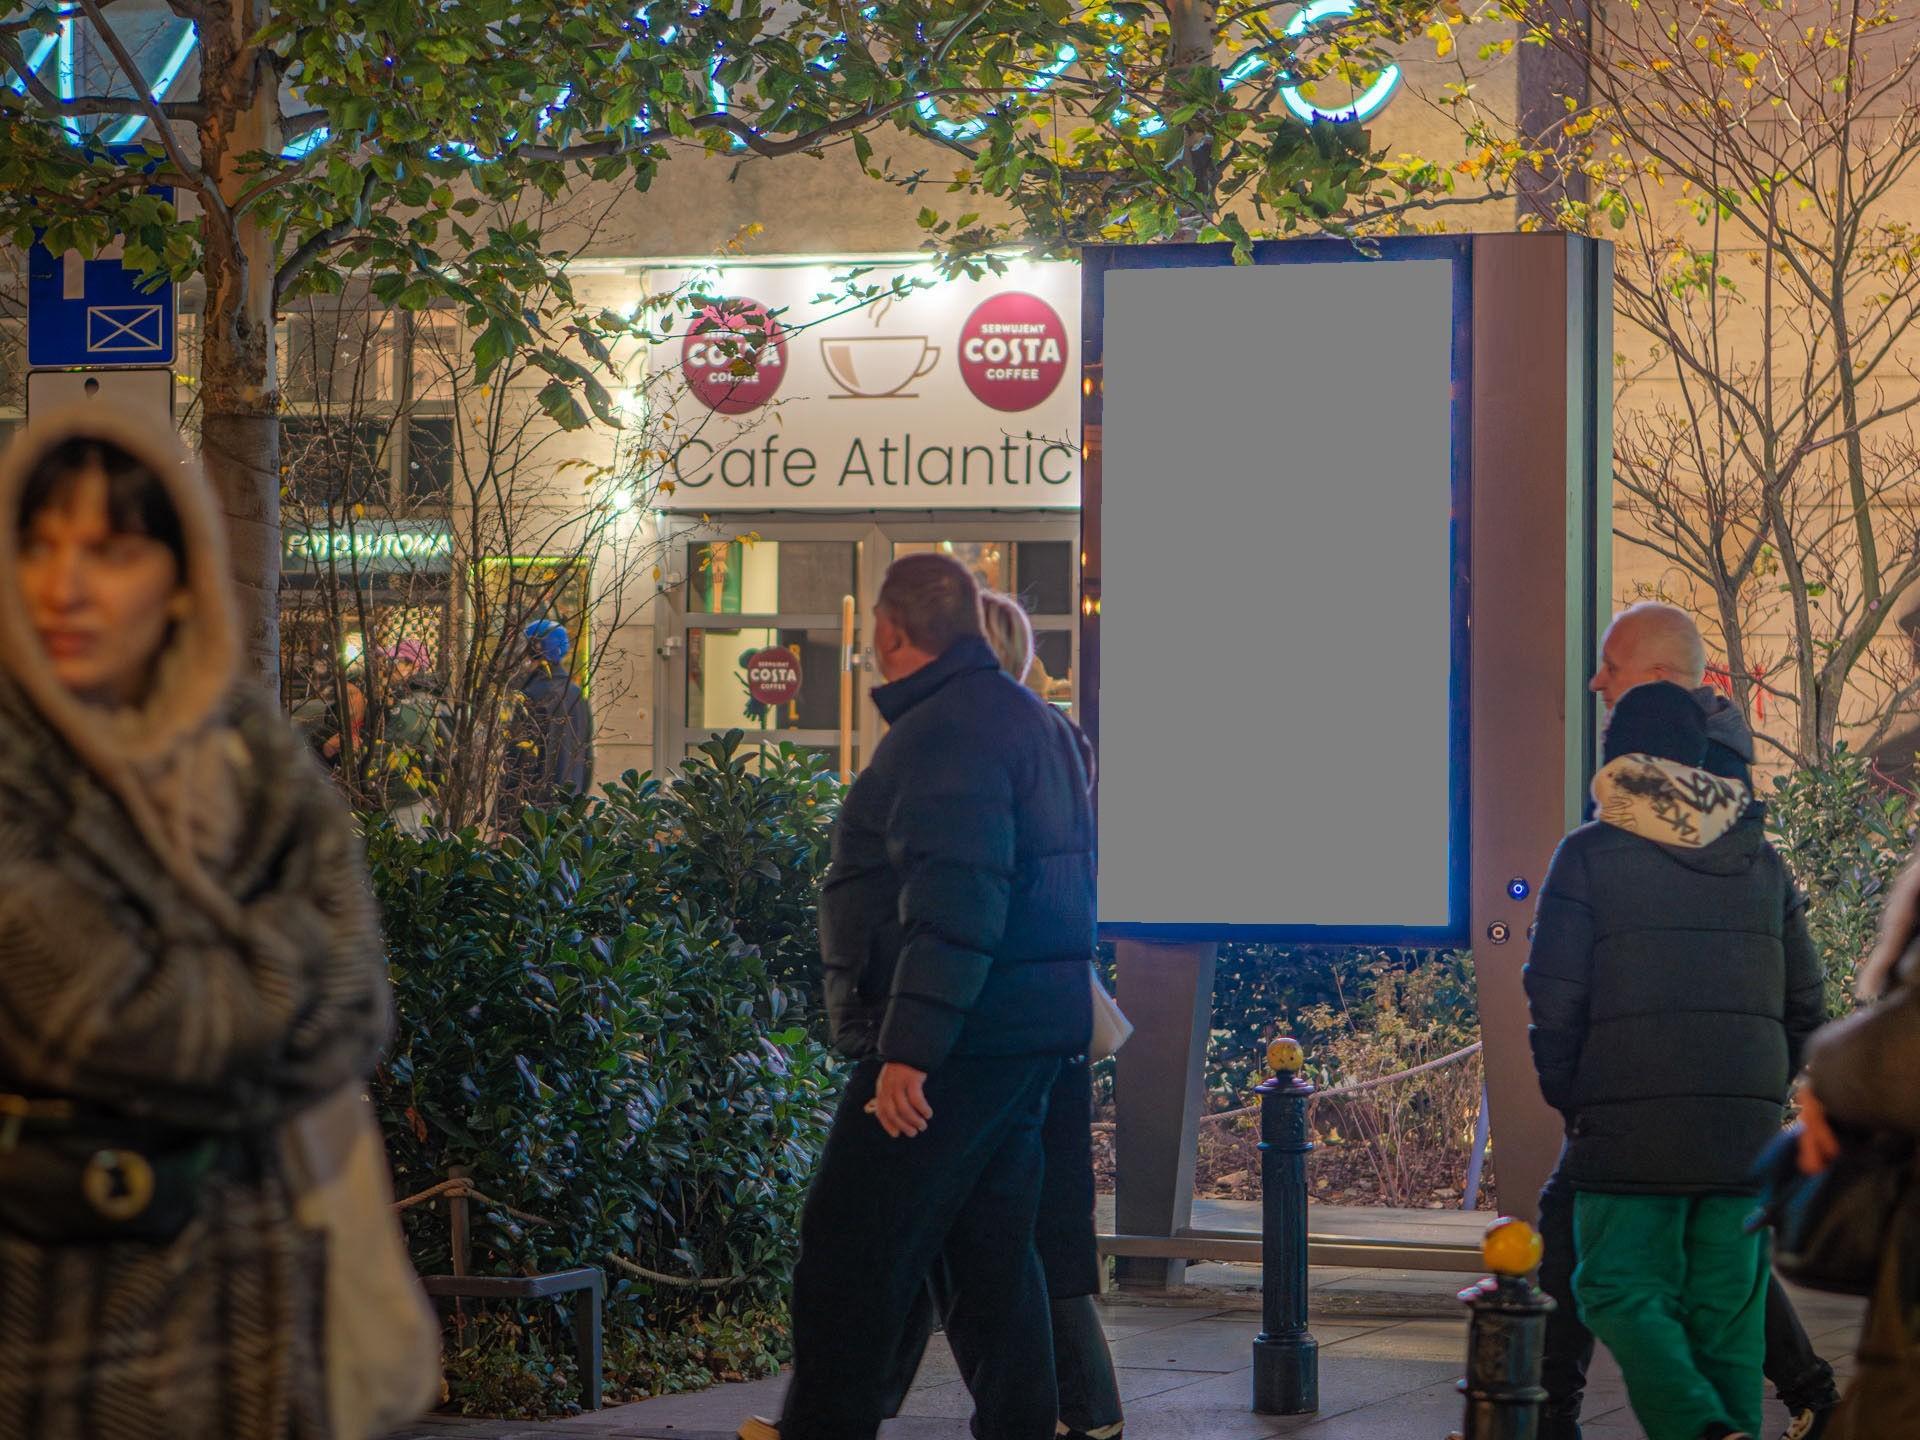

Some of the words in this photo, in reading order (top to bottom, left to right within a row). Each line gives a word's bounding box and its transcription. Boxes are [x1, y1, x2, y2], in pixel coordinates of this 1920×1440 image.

[981, 323, 1046, 334] SERWUJEMY
[688, 342, 781, 367] COA
[965, 337, 1061, 366] COSTA
[986, 368, 1039, 380] COFFEE
[675, 434, 817, 488] Cafe
[838, 433, 1072, 487] Atlantic
[750, 668, 797, 682] COSTA
